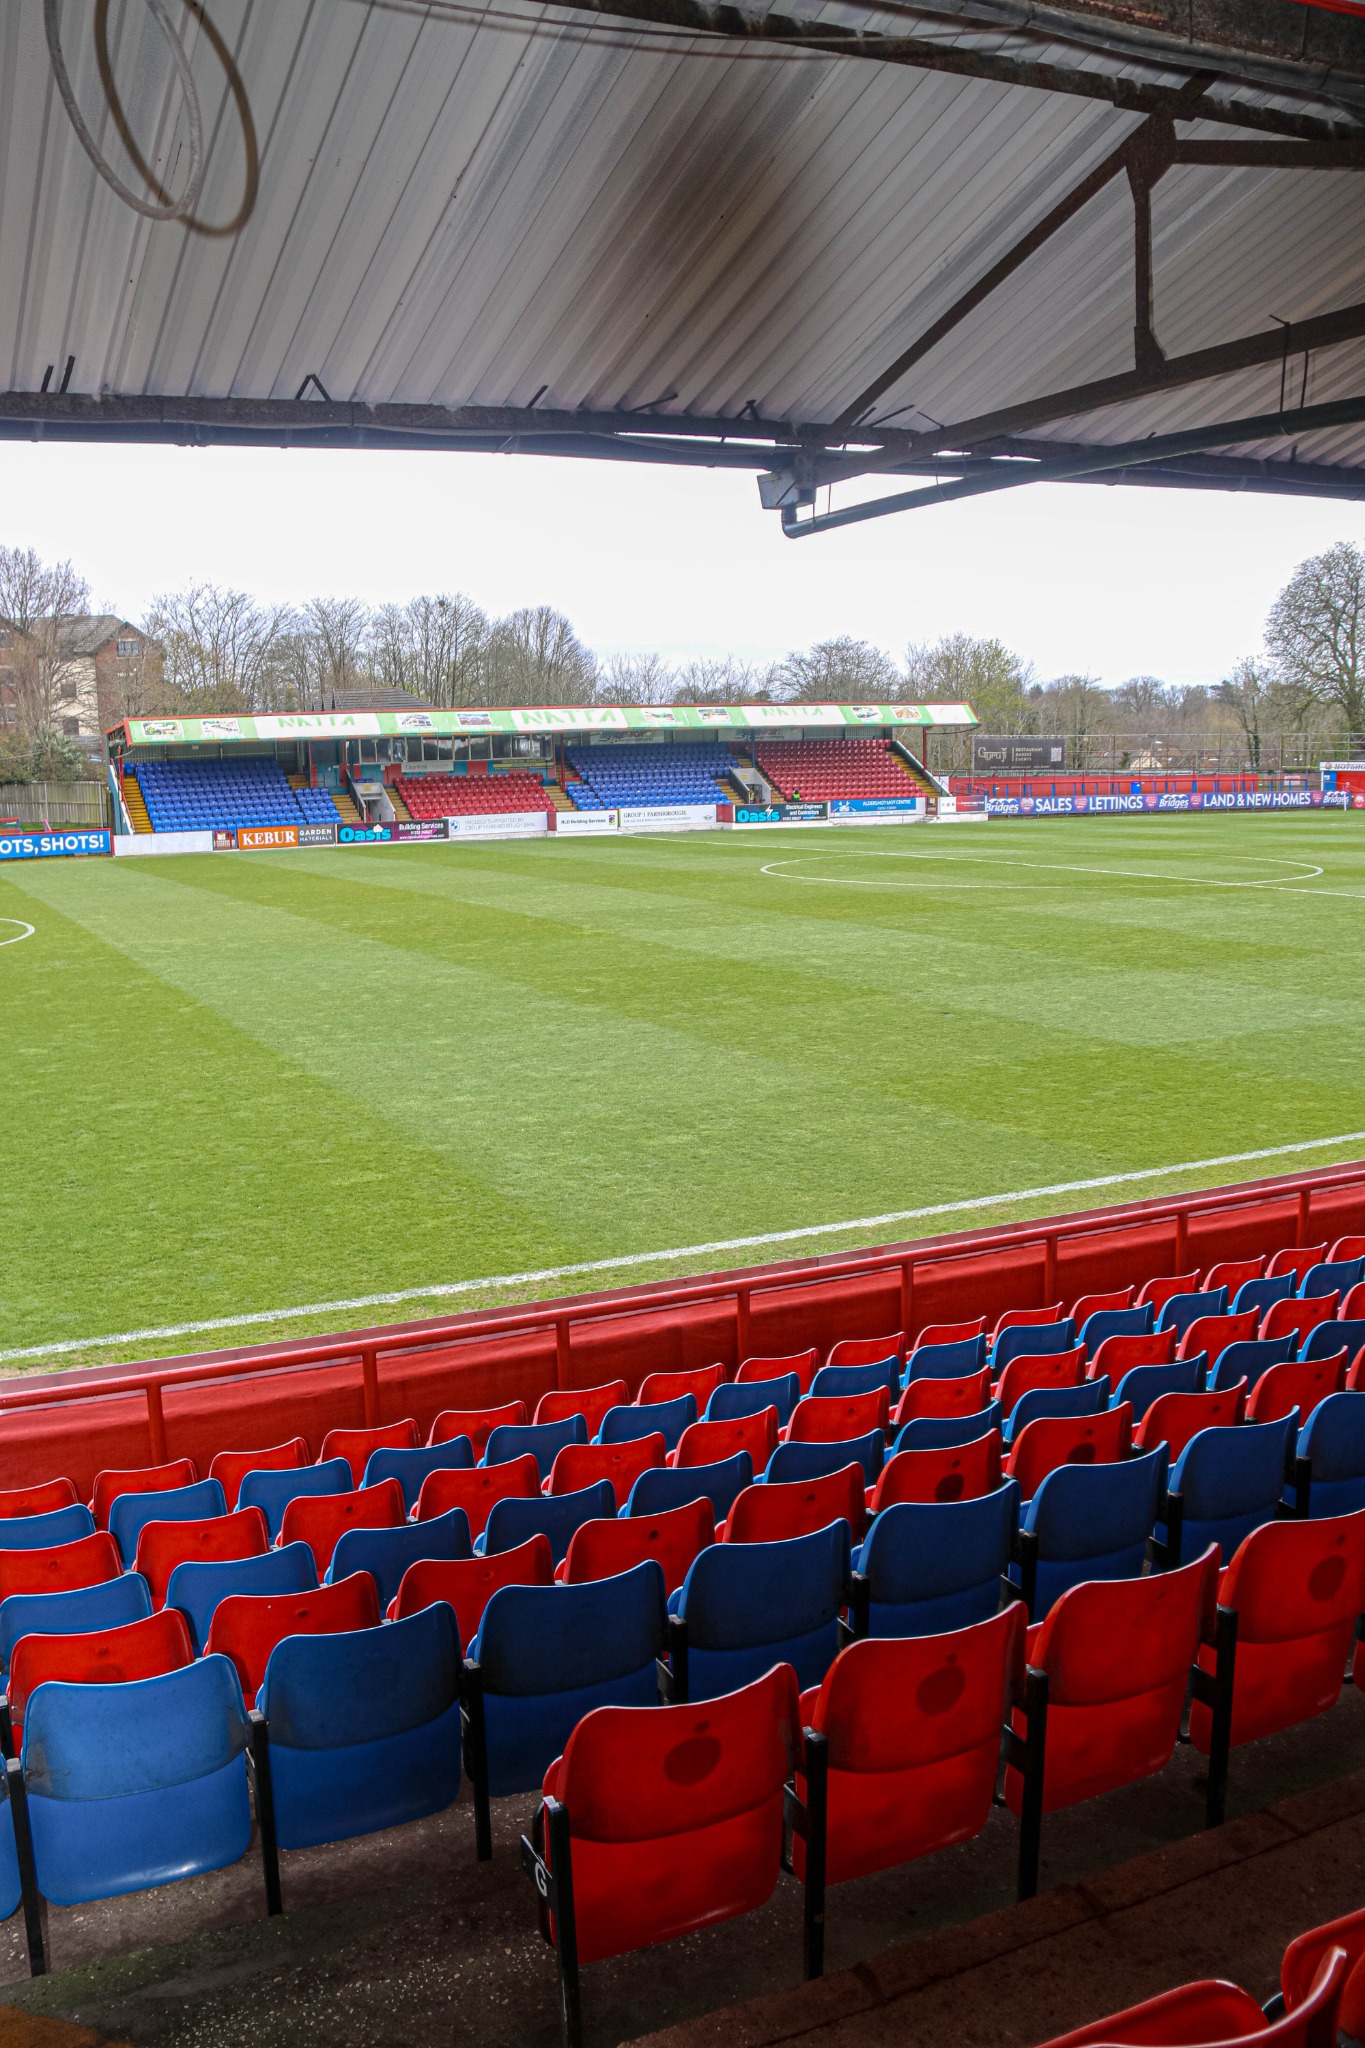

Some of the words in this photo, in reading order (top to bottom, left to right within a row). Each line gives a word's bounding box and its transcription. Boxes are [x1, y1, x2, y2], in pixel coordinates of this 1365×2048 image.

[1035, 798, 1073, 812] SALES
[1089, 796, 1144, 811] LETTINGS
[1159, 798, 1189, 808] Bridges
[1203, 794, 1235, 807] LAND
[1236, 794, 1245, 806] &
[1246, 793, 1272, 806] NEW
[1272, 792, 1311, 806] HOMES
[986, 802, 1019, 814] Bridges
[737, 809, 780, 823] Oasis
[299, 828, 332, 836] GARDEN
[399, 823, 421, 831] Building
[421, 821, 444, 830] Services
[242, 830, 296, 846] KEBUR
[339, 826, 392, 843] Oasis
[40, 834, 105, 851] SHOTS!
[534, 1861, 548, 1897] G
